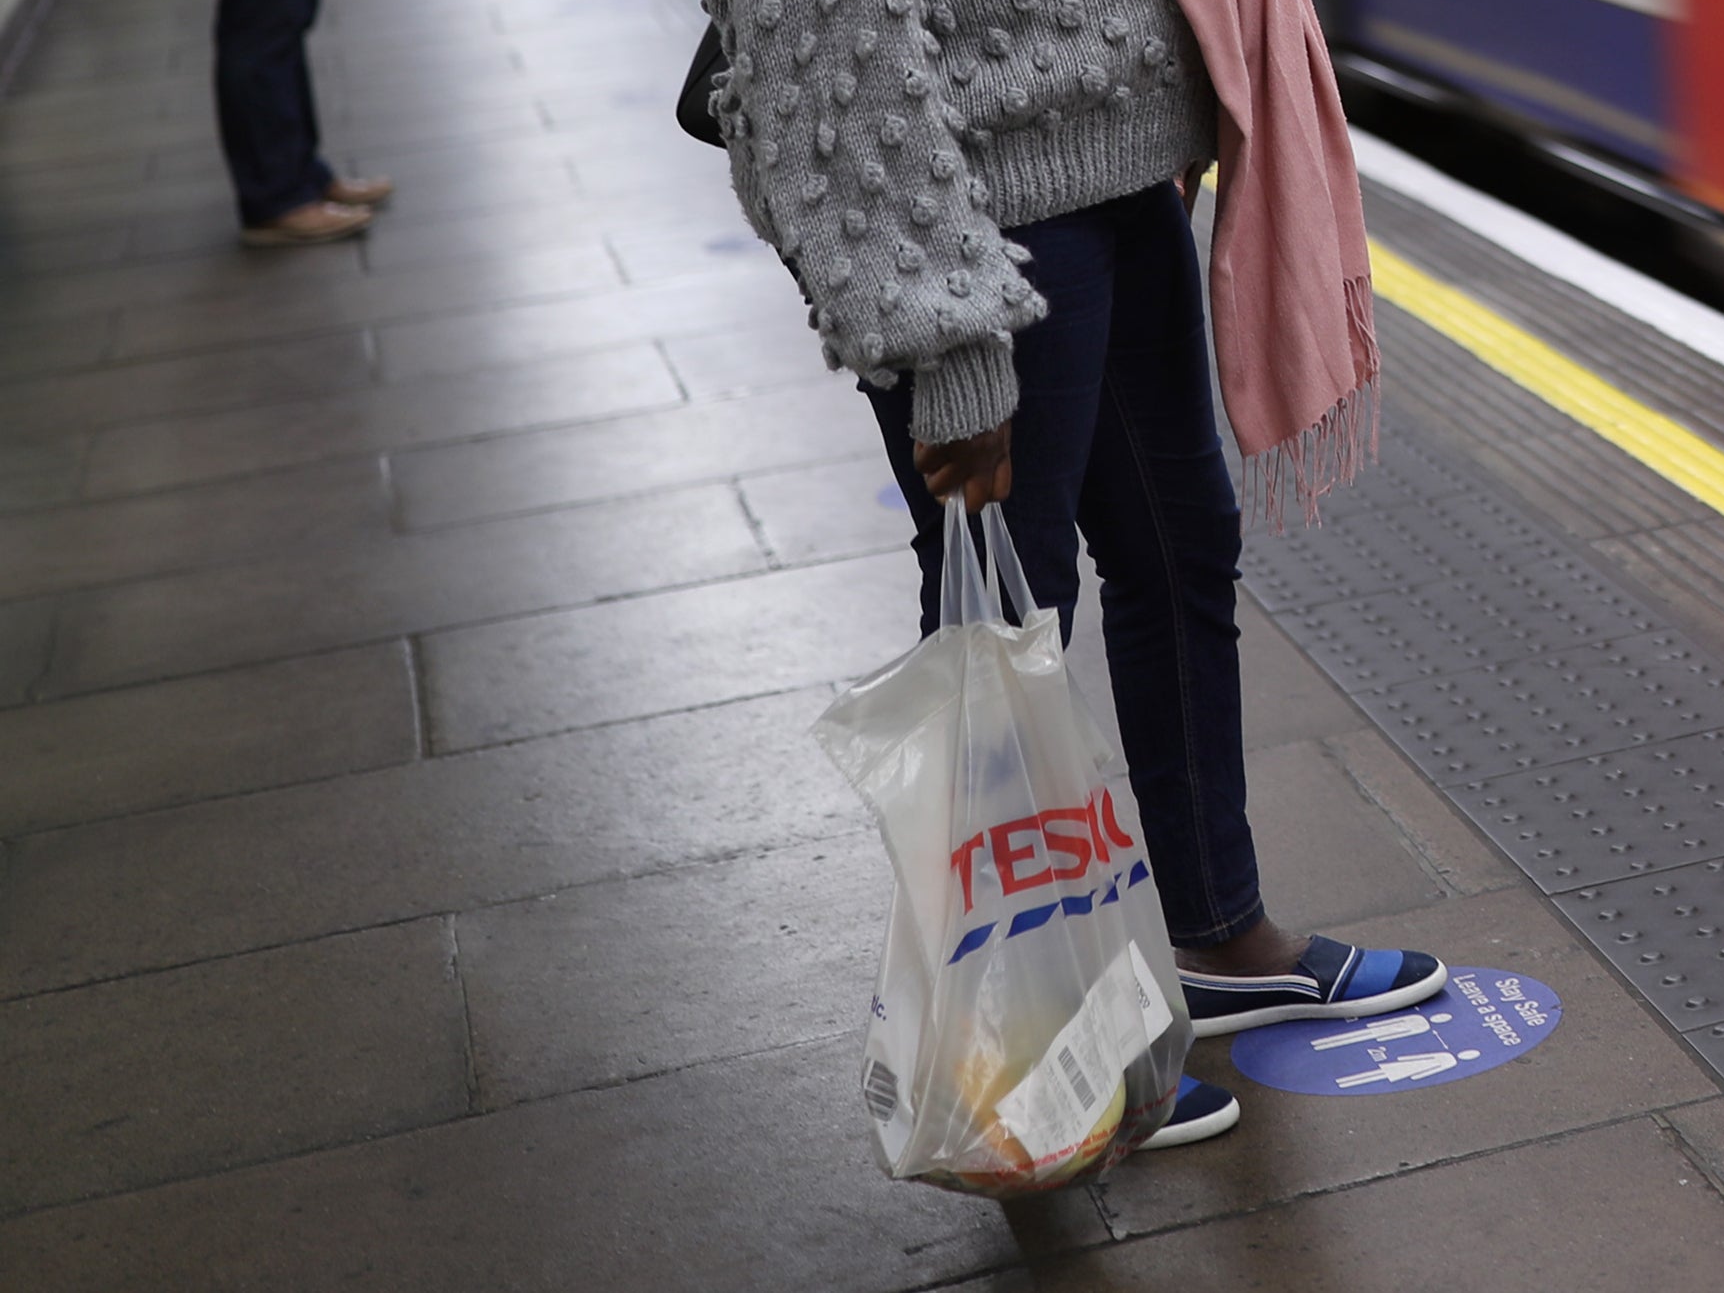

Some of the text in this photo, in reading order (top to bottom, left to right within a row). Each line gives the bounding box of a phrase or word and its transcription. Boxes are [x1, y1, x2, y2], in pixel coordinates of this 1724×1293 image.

[1453, 973, 1521, 1046] Leave a space
[1495, 977, 1548, 1027] Stay Safe
